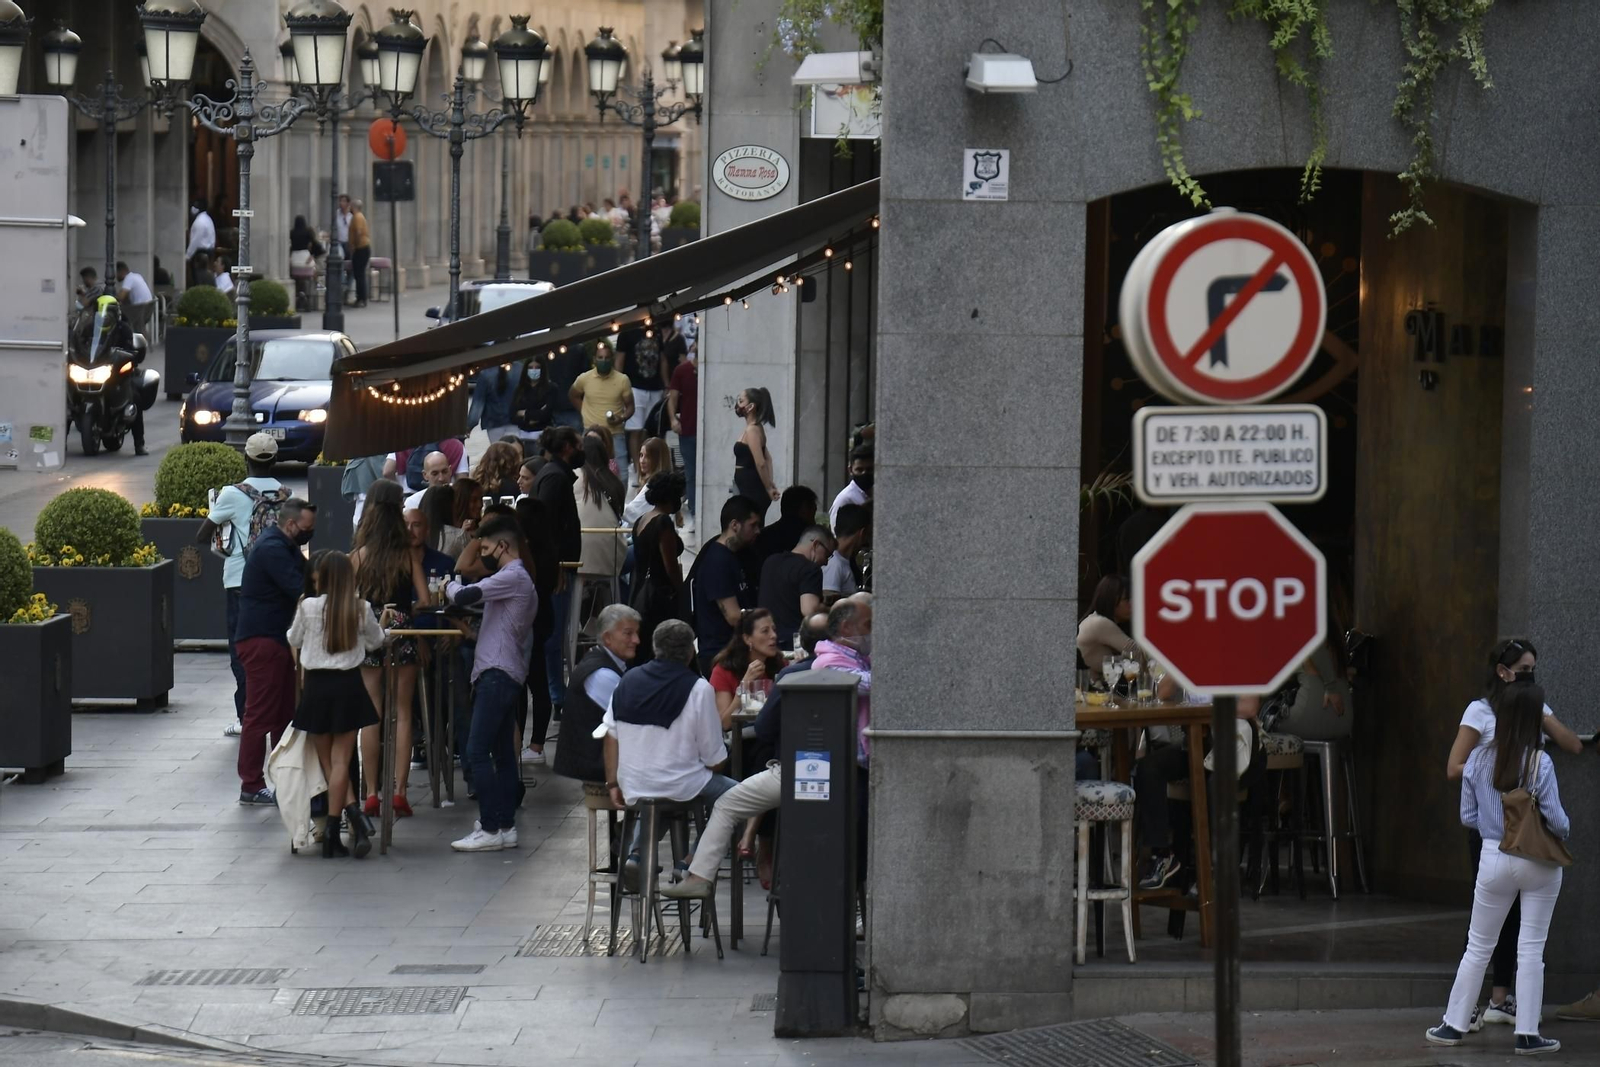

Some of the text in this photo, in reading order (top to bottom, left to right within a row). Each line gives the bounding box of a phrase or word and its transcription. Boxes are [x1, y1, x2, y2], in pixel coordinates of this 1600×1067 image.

[720, 147, 781, 166] PIZZERIA
[717, 177, 783, 197] RISTORANTE
[1156, 423, 1310, 443] DE 7:30 A 22:00 H.
[1152, 447, 1314, 466] EXCEPTO TTE. PUBLICO
[1152, 470, 1314, 488] Y VEH. AUTORIZADOS
[1158, 577, 1306, 622] STOP
